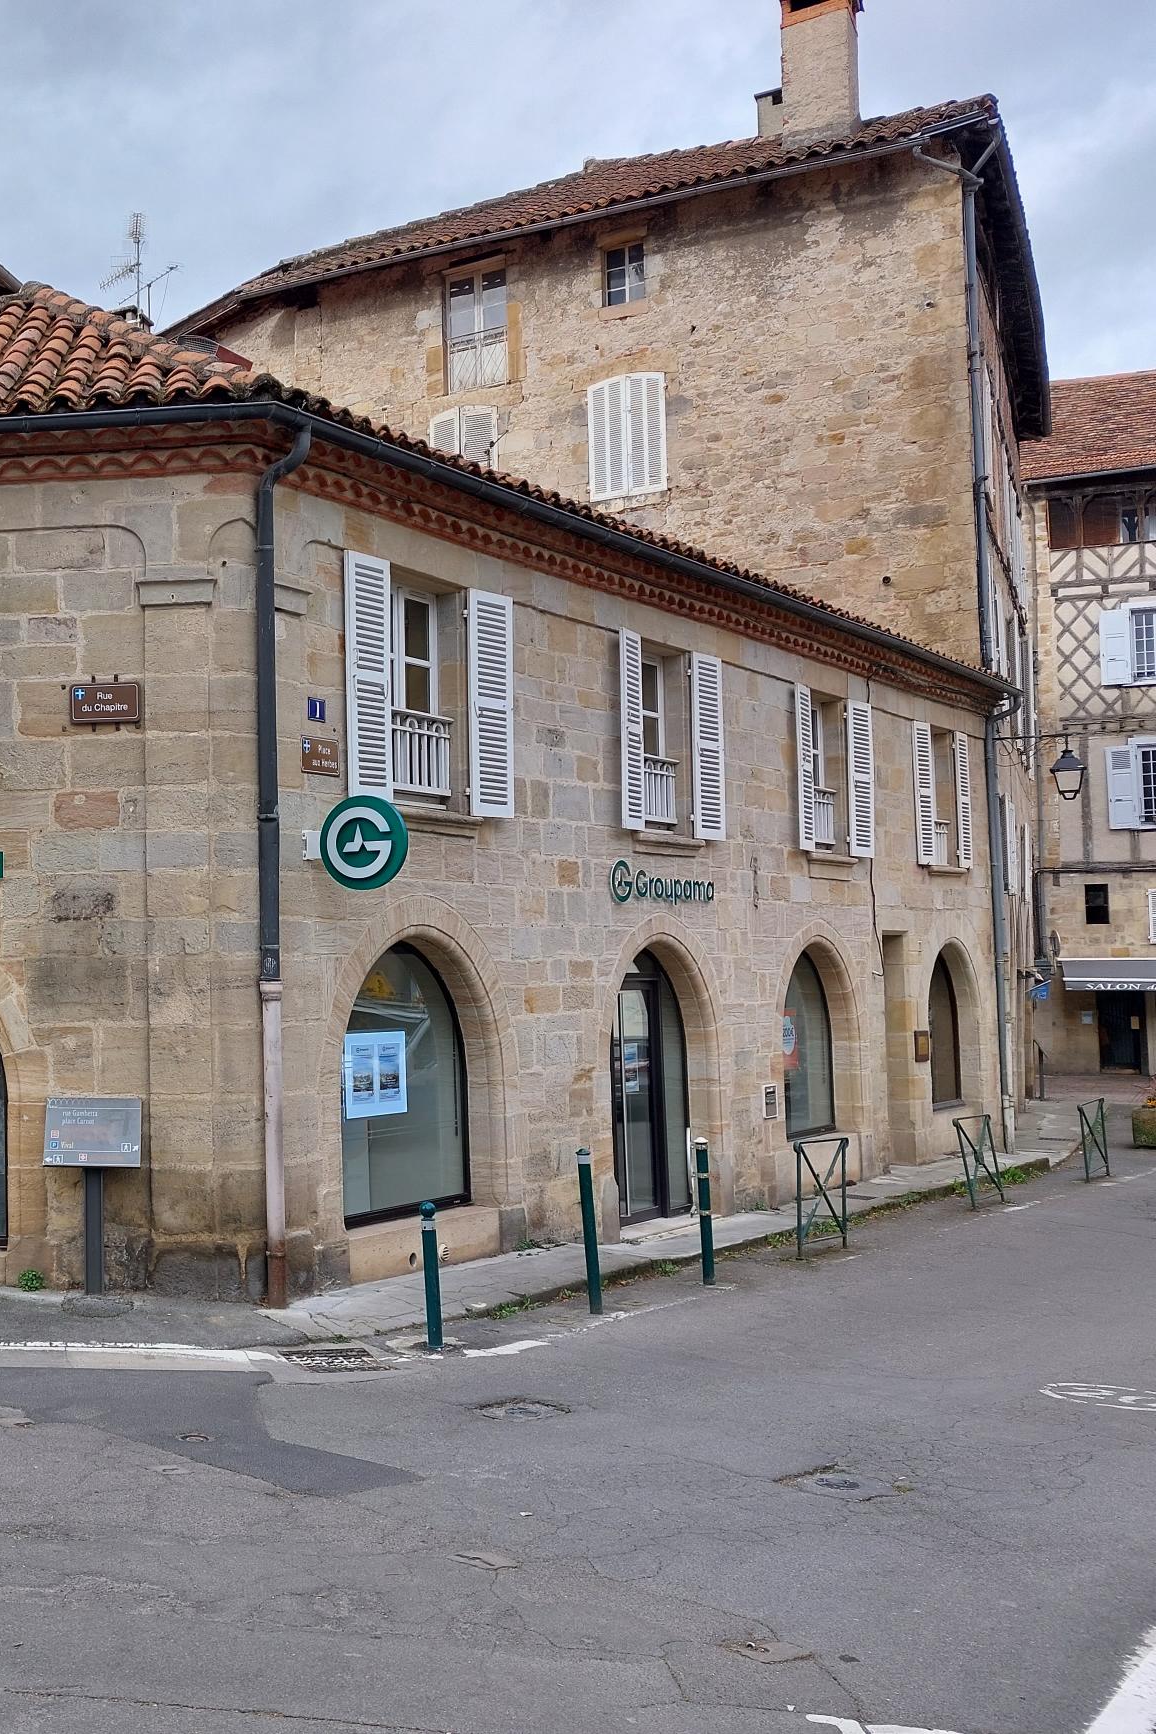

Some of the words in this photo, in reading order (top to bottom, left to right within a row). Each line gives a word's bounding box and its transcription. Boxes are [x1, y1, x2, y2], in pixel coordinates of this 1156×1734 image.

[96, 691, 113, 700] Rue
[81, 704, 92, 712] du
[93, 703, 128, 712] Chapitre
[315, 701, 320, 718] 1
[318, 744, 331, 755] Place
[312, 759, 321, 767] aux
[321, 758, 338, 769] Herbes
[635, 869, 715, 905] Groupama
[1085, 983, 1141, 991] SALON
[72, 1109, 98, 1117] Gambetta
[62, 1118, 76, 1126] place
[60, 1141, 74, 1149] Vival
